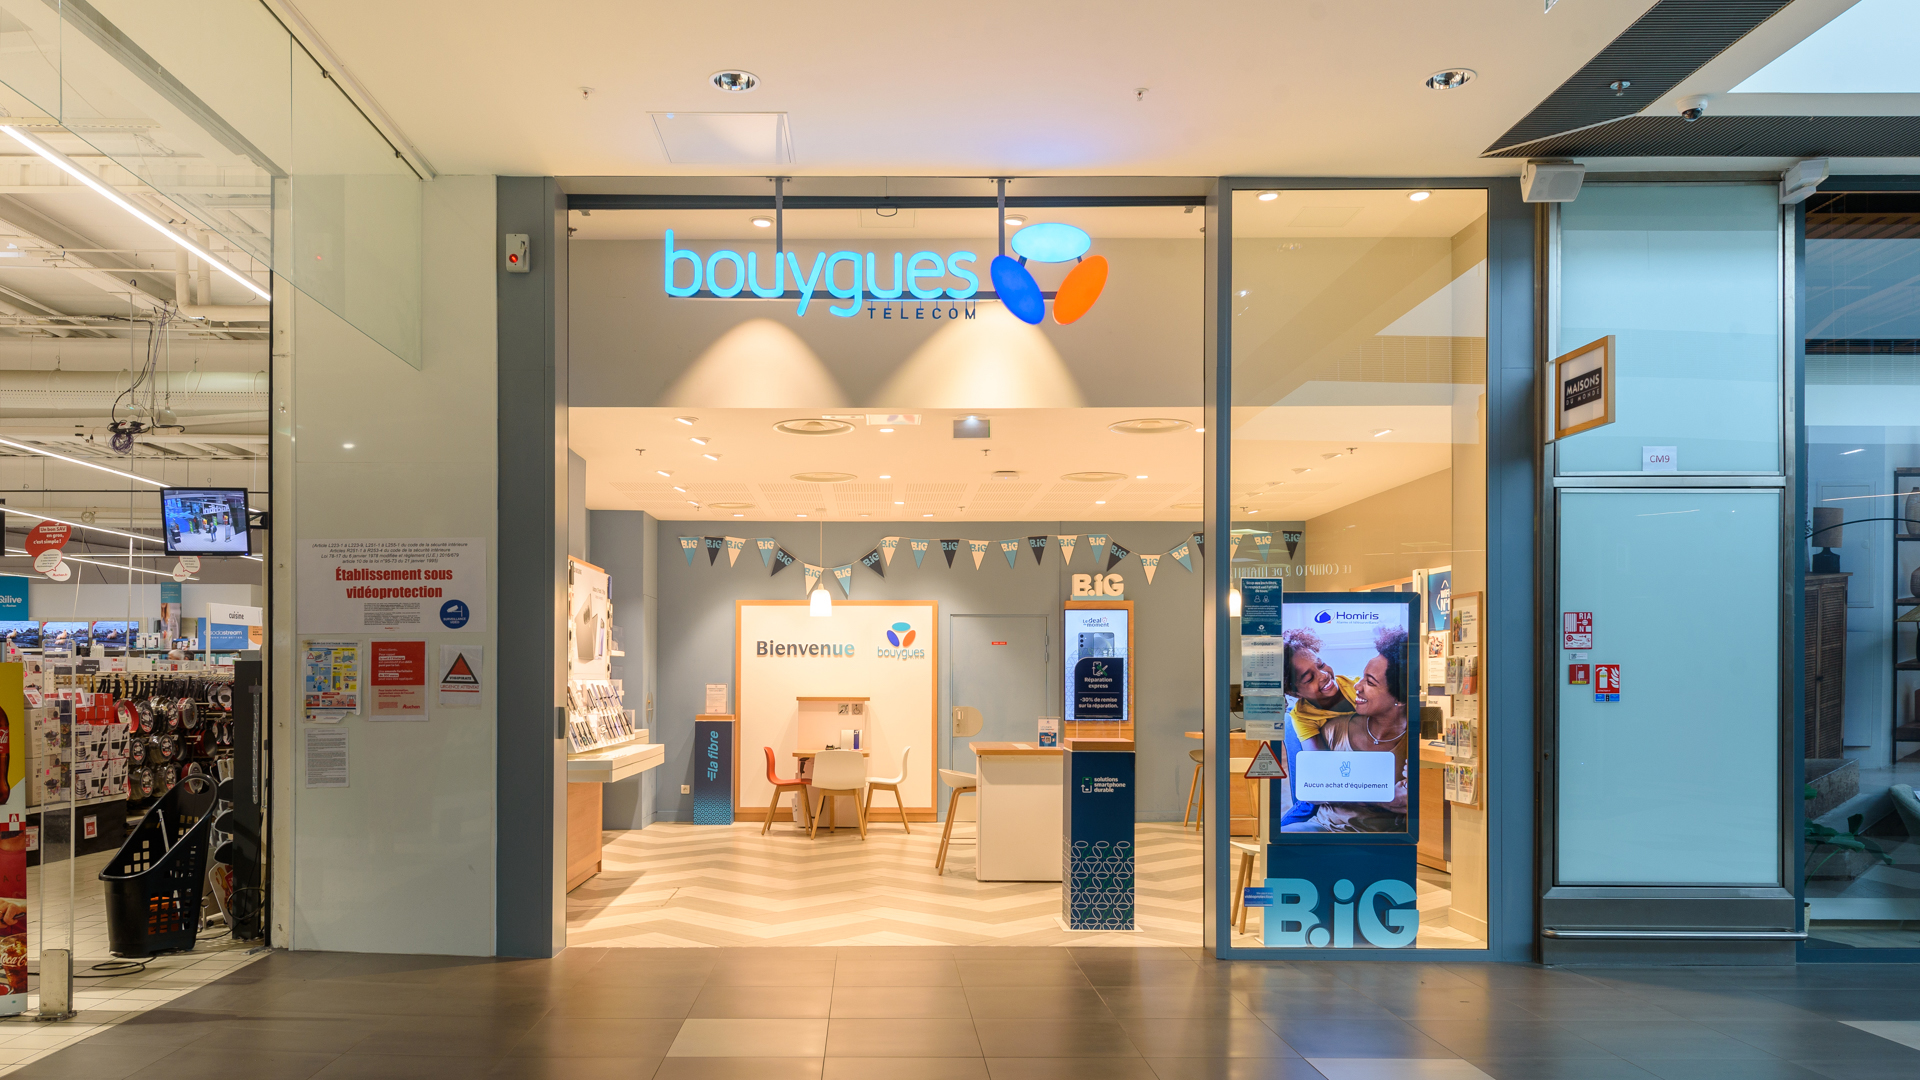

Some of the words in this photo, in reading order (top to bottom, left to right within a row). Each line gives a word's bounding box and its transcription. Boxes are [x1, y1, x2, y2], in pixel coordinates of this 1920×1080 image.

[665, 229, 979, 317] bouygues
[1566, 374, 1599, 396] MAISONS
[1578, 388, 1599, 402] MONDE
[1649, 454, 1670, 463] CM9
[336, 566, 422, 581] Établissement
[424, 569, 453, 580] sous
[1072, 573, 1125, 597] B.iG
[346, 586, 442, 600] vidéoprotection
[229, 611, 244, 620] cuisine
[1336, 611, 1379, 620] Homiris
[756, 640, 855, 656] Bienvenue
[878, 646, 925, 660] bouygues
[708, 730, 719, 759] fibre
[710, 762, 719, 773] la
[1264, 878, 1419, 948] B.iG
